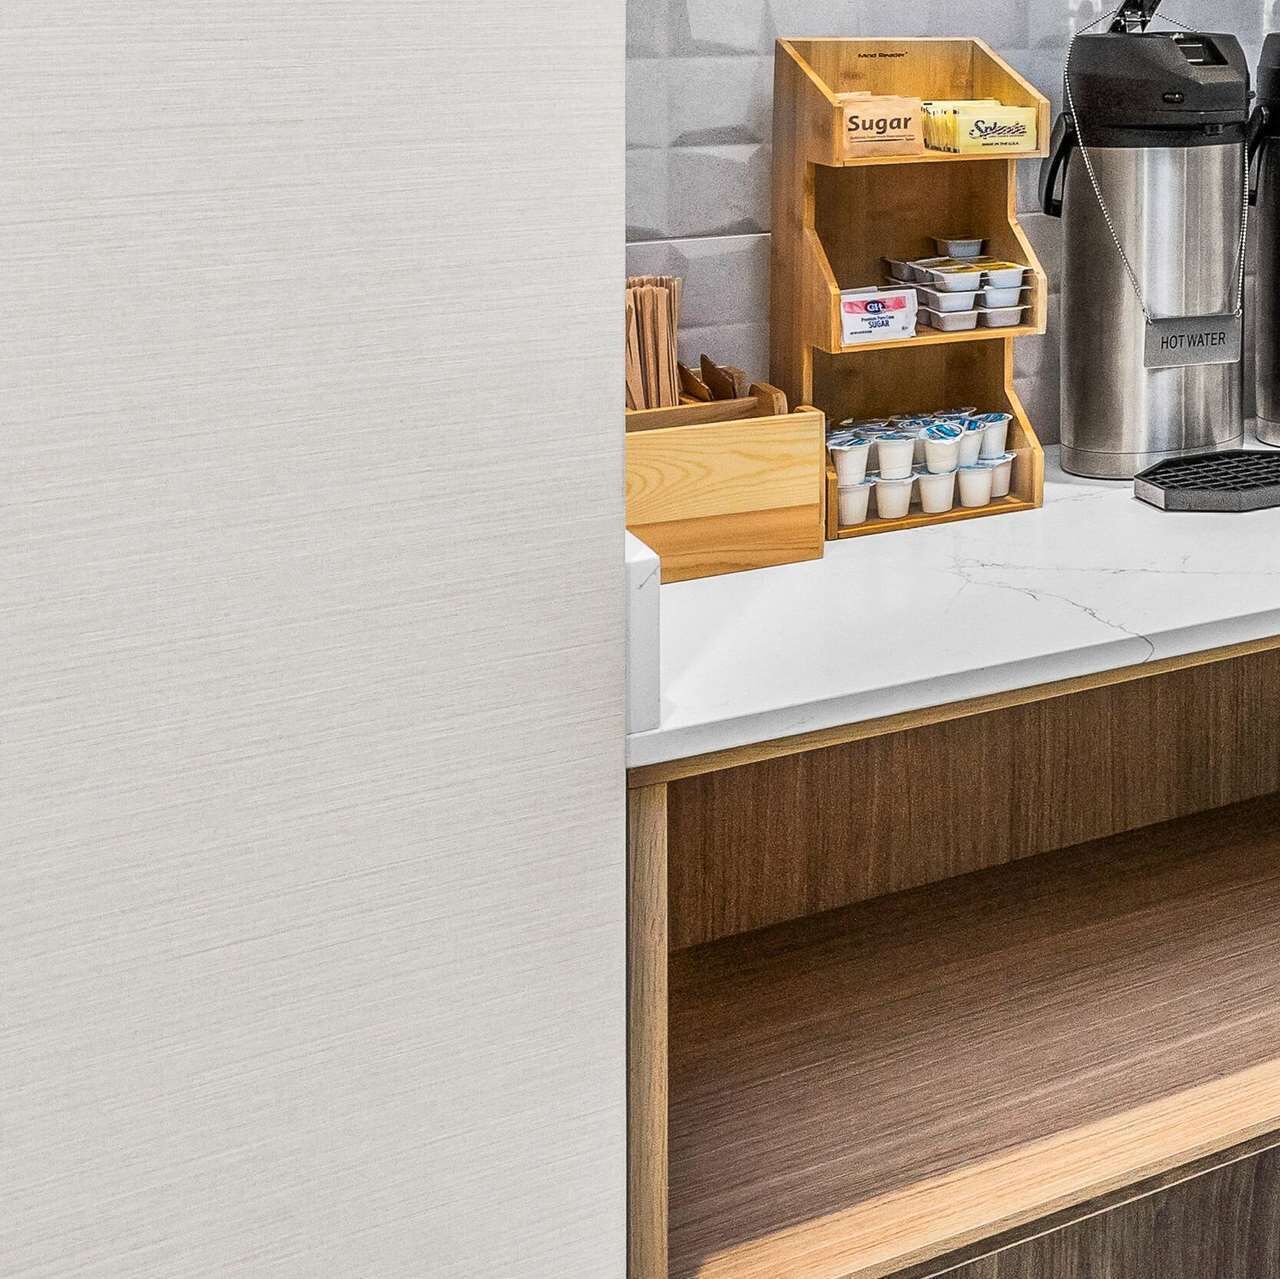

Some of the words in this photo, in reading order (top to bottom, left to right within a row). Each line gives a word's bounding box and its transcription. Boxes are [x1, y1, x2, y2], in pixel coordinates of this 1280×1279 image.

[847, 115, 912, 134] Sugar
[868, 320, 890, 329] SUGAR
[1160, 334, 1184, 350] HOT
[1187, 331, 1226, 348] WATER
